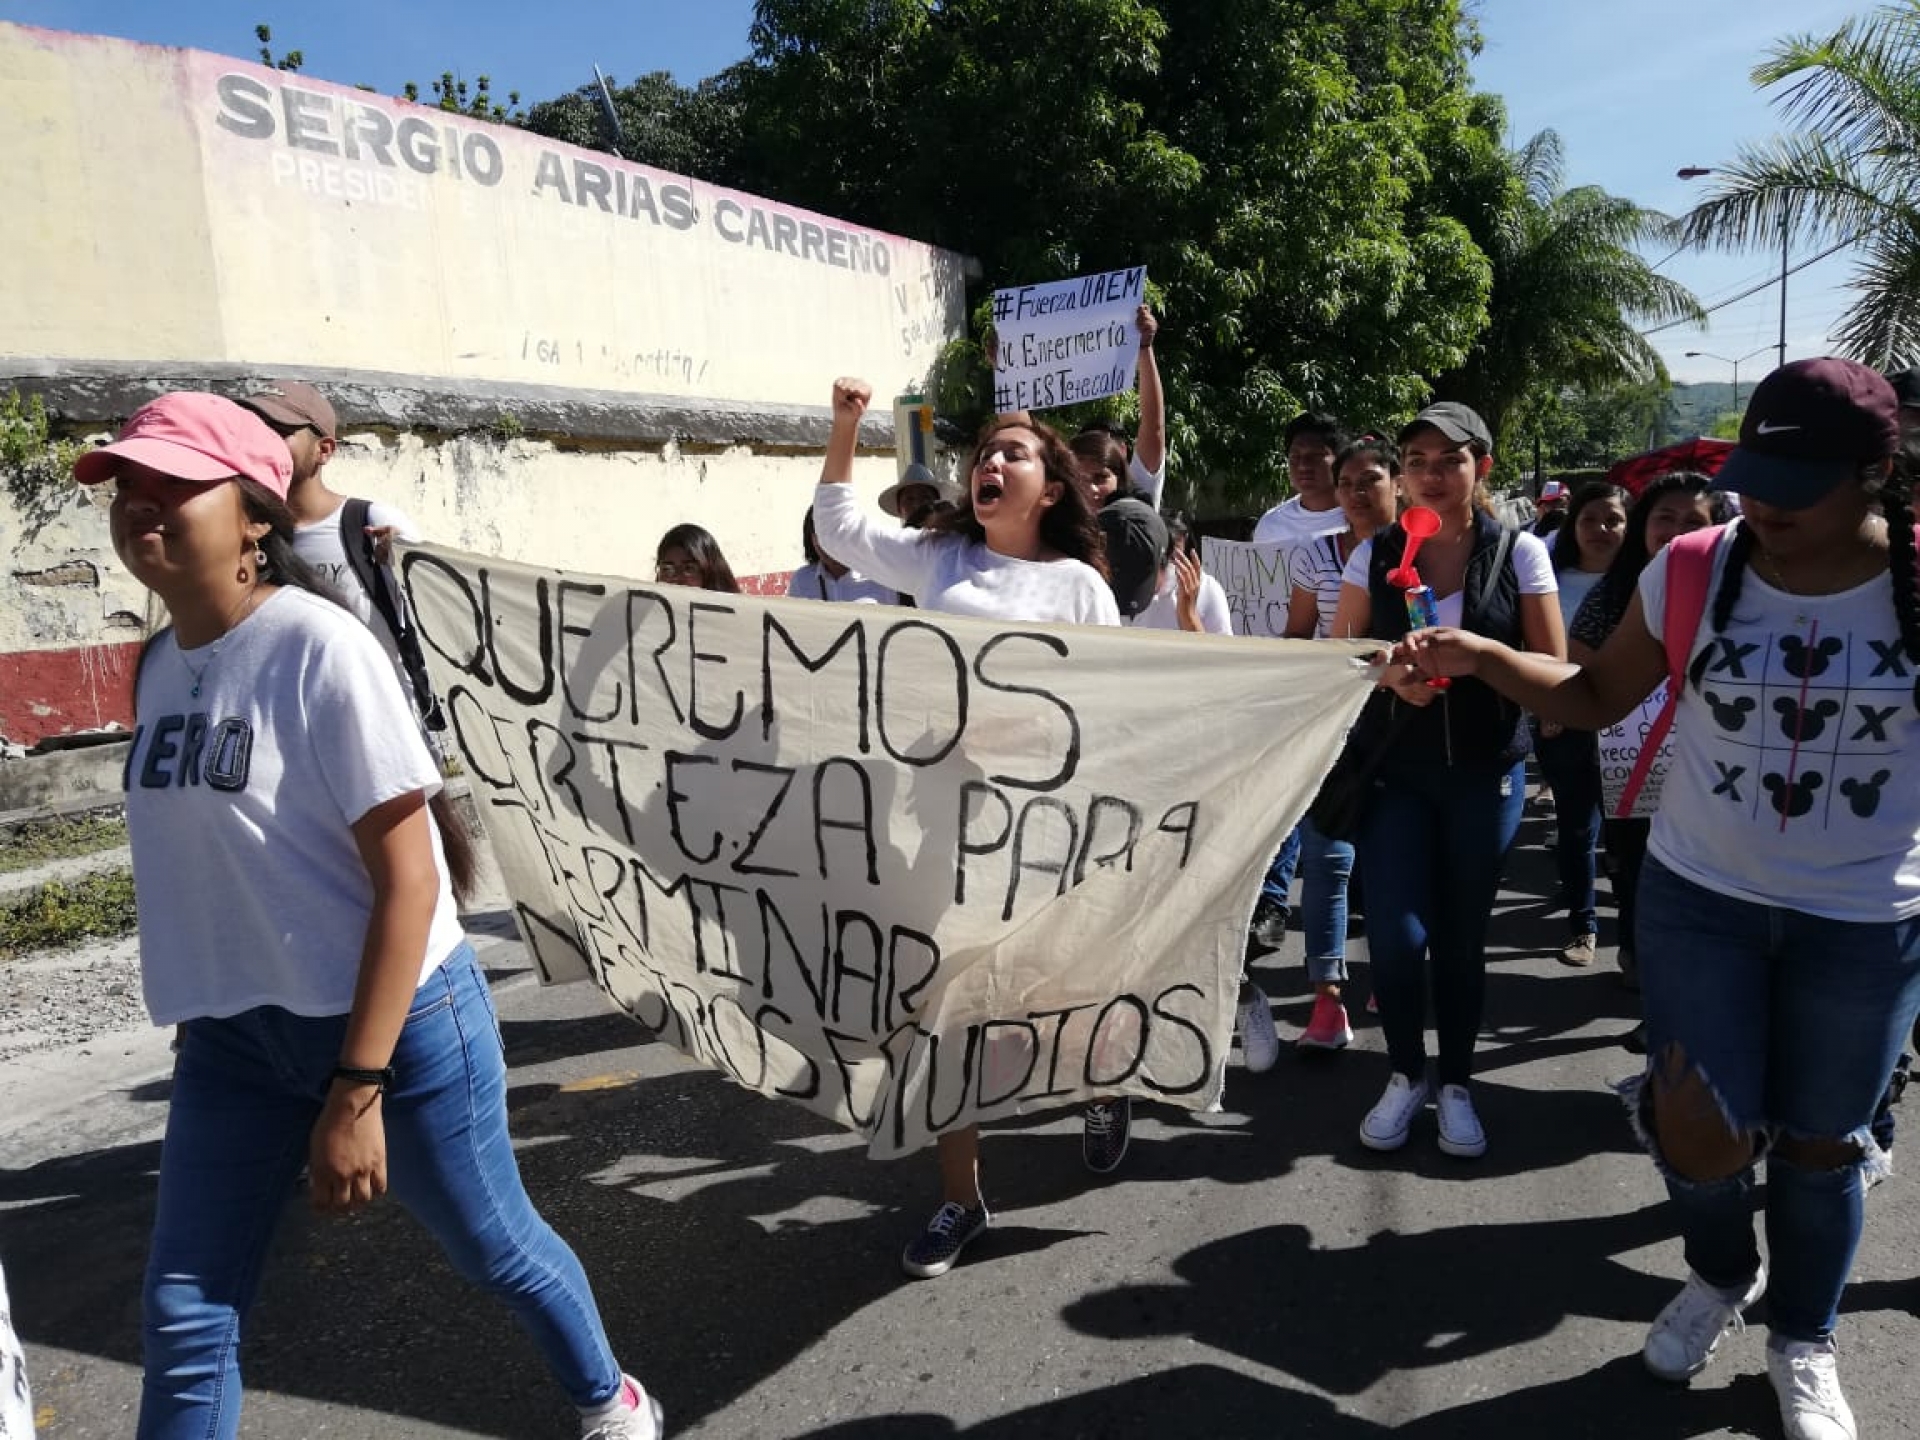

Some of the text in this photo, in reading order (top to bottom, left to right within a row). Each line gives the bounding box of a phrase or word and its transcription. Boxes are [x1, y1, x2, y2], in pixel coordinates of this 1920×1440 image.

[216, 73, 504, 188] SERGIO
[533, 150, 694, 231] ARIAS
[402, 551, 1081, 792] QUEREMOS
[447, 684, 1199, 921] CERTEZA PARA
[491, 797, 940, 1035] TERMINAR
